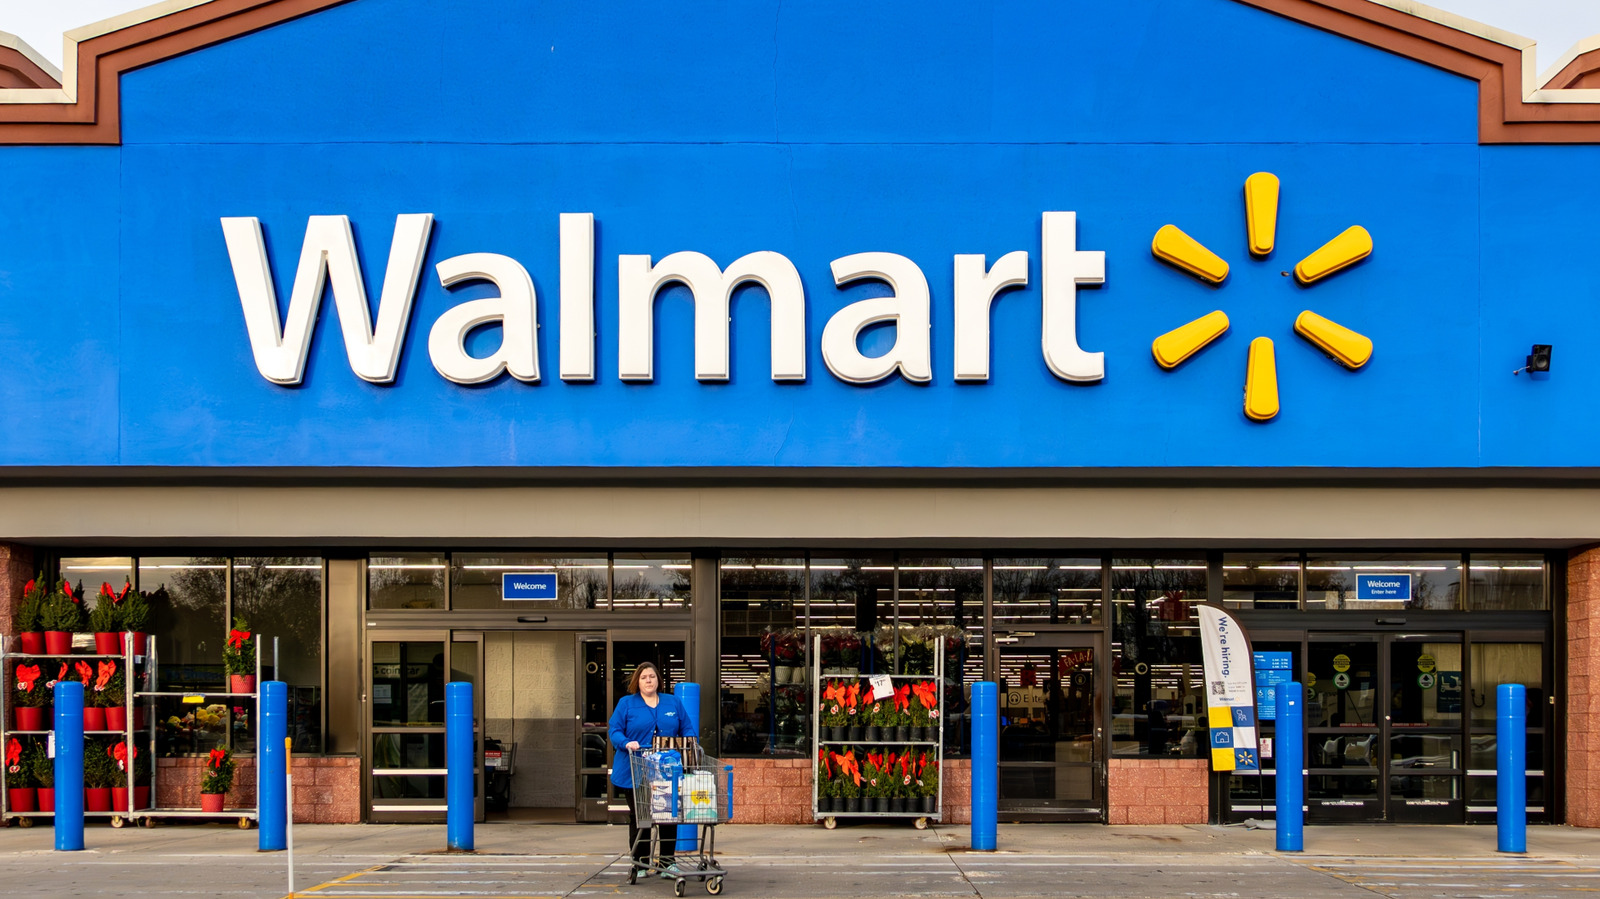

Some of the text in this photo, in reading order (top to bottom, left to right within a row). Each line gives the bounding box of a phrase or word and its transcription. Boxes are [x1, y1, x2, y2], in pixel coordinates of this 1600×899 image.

[220, 211, 1106, 385] Walmart
[513, 582, 547, 590] Welcome
[1367, 580, 1401, 588] Welcome
[1218, 616, 1232, 678] We're hiring.
[381, 667, 419, 675] coinar
